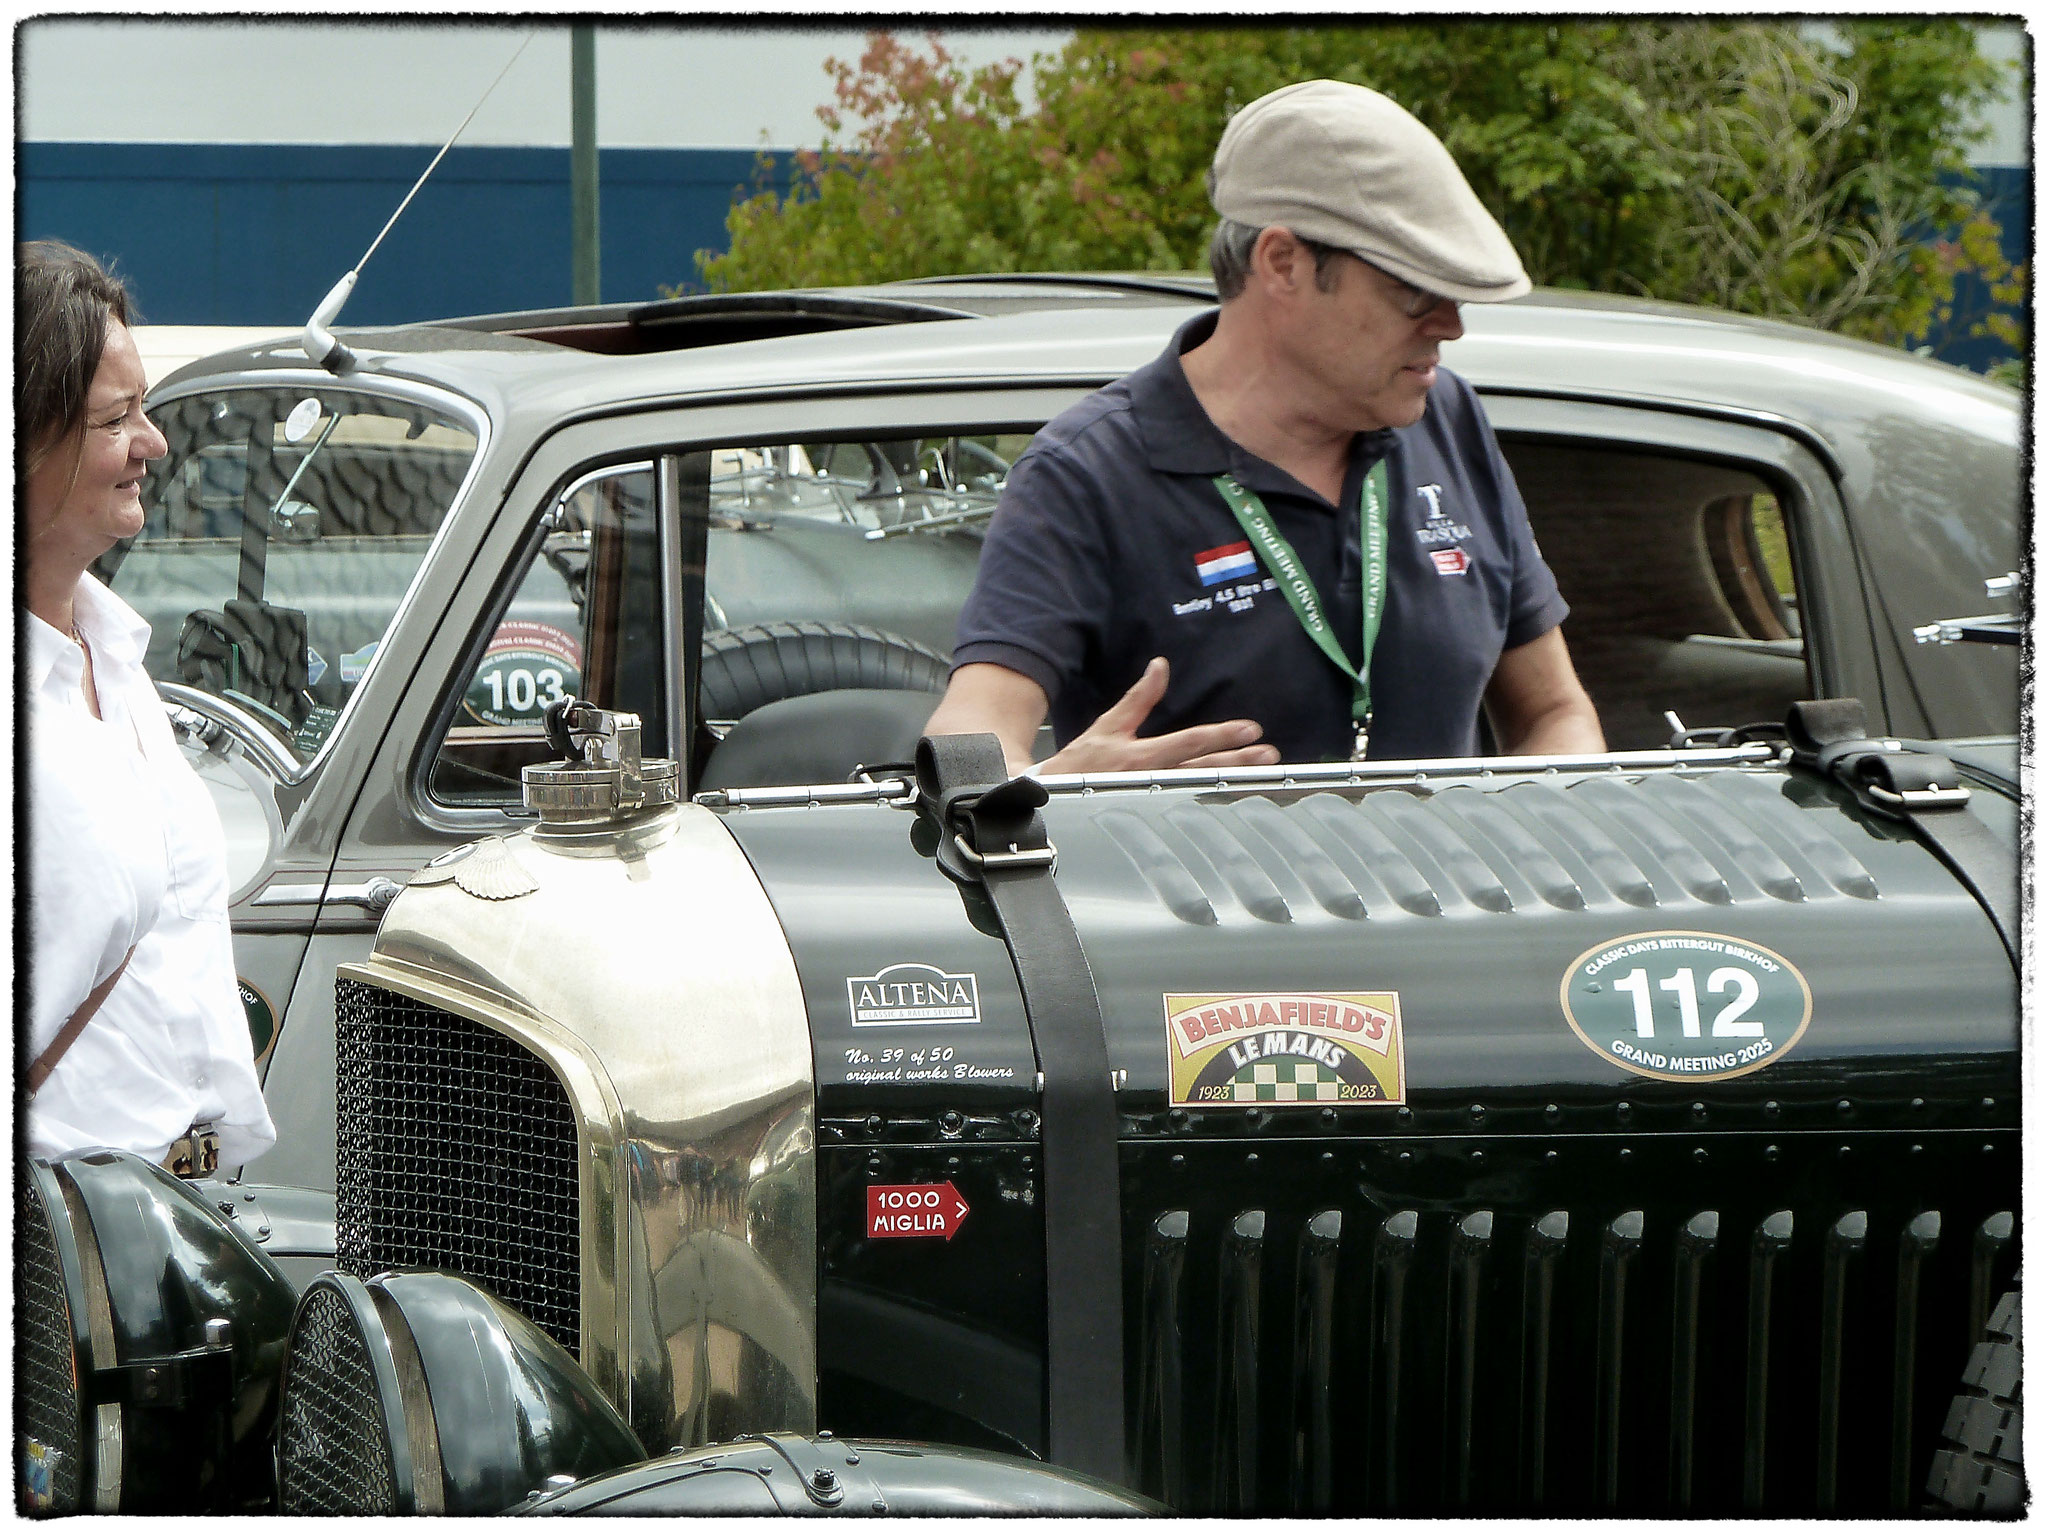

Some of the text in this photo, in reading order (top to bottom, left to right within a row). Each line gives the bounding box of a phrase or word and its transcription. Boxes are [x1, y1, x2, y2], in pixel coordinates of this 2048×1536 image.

[1252, 516, 1324, 632] GRAND MEETING
[483, 668, 565, 712] 103
[1584, 938, 1781, 976] CLASSIC DAYS RITTERGUT BIRKHOF
[857, 981, 972, 1007] ALTENA
[1613, 966, 1765, 1038] 112
[863, 1010, 896, 1018] CLASSIC
[907, 1009, 930, 1017] RALLY
[931, 1008, 966, 1016] SERVICE
[1179, 1001, 1387, 1044] BENJAFIELD'S
[844, 1046, 954, 1066] No. 39 of 50
[1227, 1031, 1348, 1070] LE MANS
[1611, 1037, 1773, 1071] GRAND MEETING 2025
[845, 1063, 1014, 1086] original works Blowers
[1198, 1085, 1231, 1101] 1923
[1340, 1084, 1378, 1099] 2023
[878, 1191, 941, 1209] 1000
[873, 1213, 946, 1232] MIGLIA
